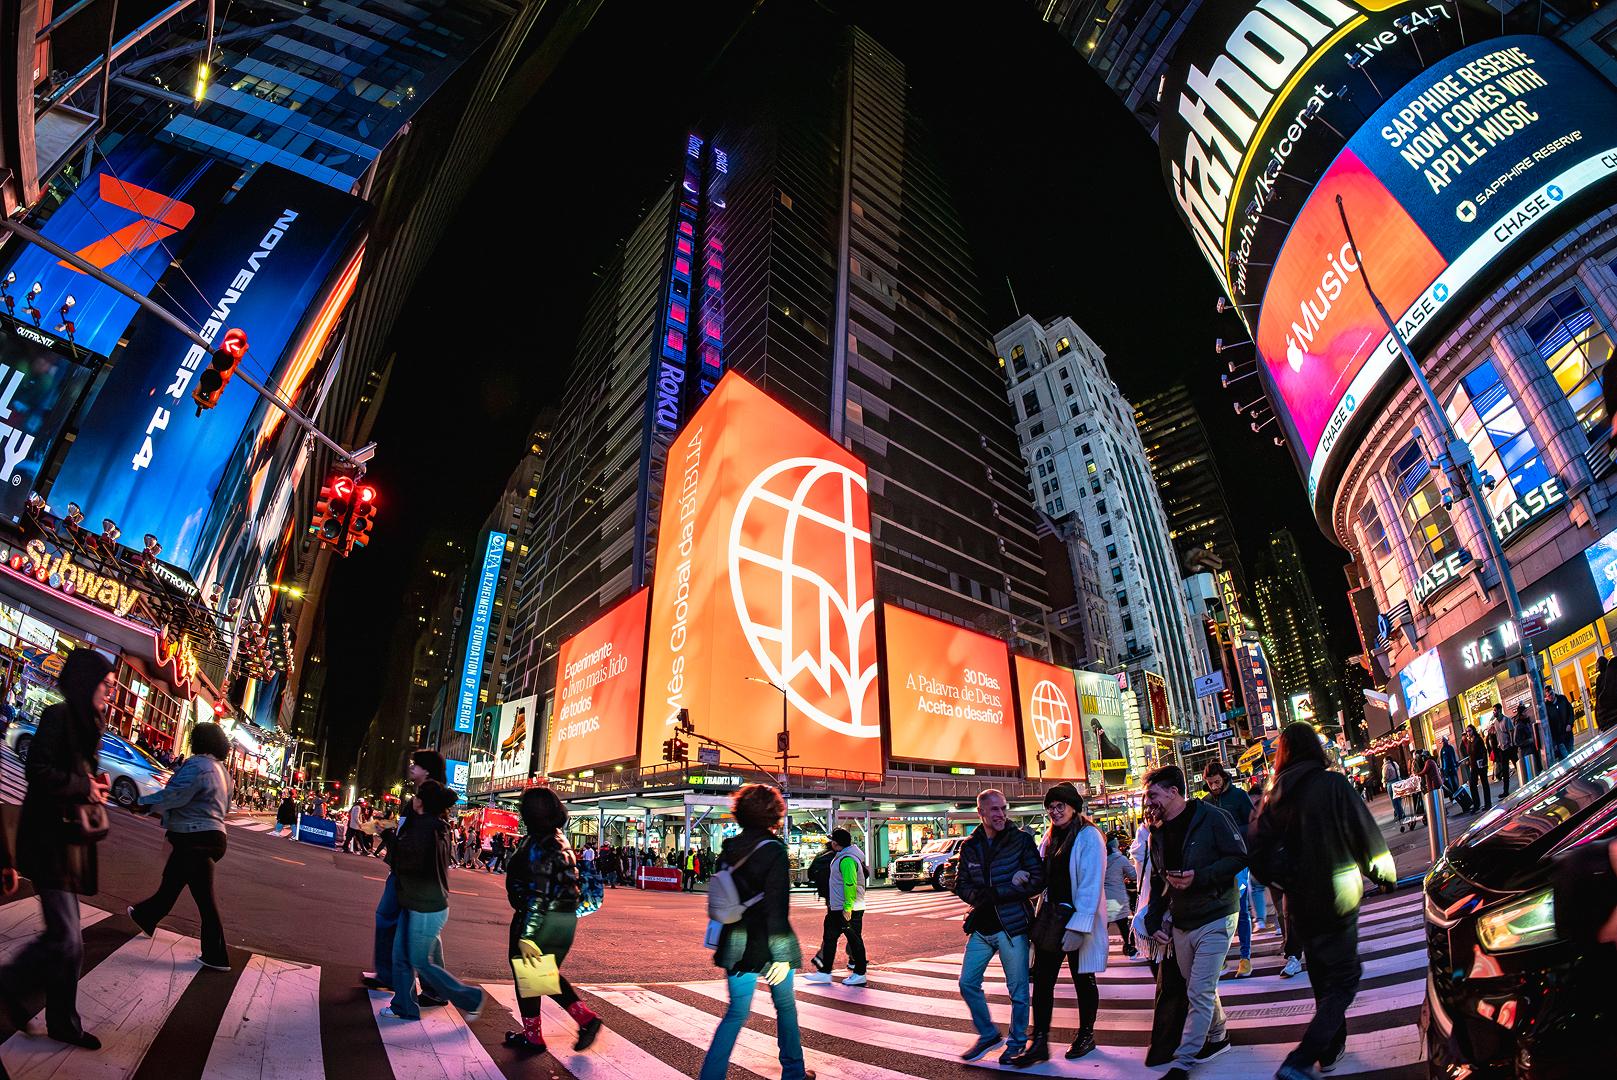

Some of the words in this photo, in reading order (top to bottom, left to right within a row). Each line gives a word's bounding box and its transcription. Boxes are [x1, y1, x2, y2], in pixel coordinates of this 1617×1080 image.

[1344, 30, 1397, 67] Live
[1381, 74, 1468, 148] SAPPHIRE
[1456, 47, 1536, 87] RESERVE
[1400, 123, 1448, 171] NOW
[1441, 84, 1507, 133] COMES
[1495, 68, 1548, 97] WITH
[1424, 133, 1488, 195] APPLE
[1475, 100, 1539, 147] MUSIC
[1475, 157, 1534, 206] SAPPHIRE
[1494, 195, 1550, 242] CHASE
[165, 209, 300, 399] NOVEMBER
[1294, 241, 1362, 353] Music
[131, 407, 171, 472] 14
[1322, 407, 1348, 453] CHASE
[1492, 478, 1564, 540] HASE
[678, 520, 694, 558] da
[27, 539, 141, 617] Subway
[476, 571, 495, 624] ALZHEIMER'S
[1413, 551, 1464, 603] HASE
[670, 558, 692, 655] Global
[1219, 570, 1243, 637] MADAME
[466, 624, 486, 676] FOUNDATION
[564, 641, 613, 681] Experimente
[1551, 642, 1569, 660] STEVE
[1569, 627, 1594, 653] MADDEN
[466, 677, 477, 690] OF
[562, 688, 568, 701] o
[568, 676, 585, 699] livro
[587, 664, 608, 690] mais
[608, 655, 628, 680] lido
[906, 673, 917, 691] A
[918, 673, 960, 700] Palavra
[961, 686, 975, 702] de
[975, 688, 1002, 708] Deus.
[963, 668, 977, 685] 30
[978, 672, 1001, 691] Dias.
[458, 690, 475, 730] AMERICA
[560, 702, 570, 721] de
[570, 695, 592, 718] todos
[917, 695, 954, 717] Aceita
[955, 707, 963, 719] o
[963, 705, 1004, 725] desafio?
[1081, 694, 1121, 717] MANHATTAN
[558, 727, 567, 742] os
